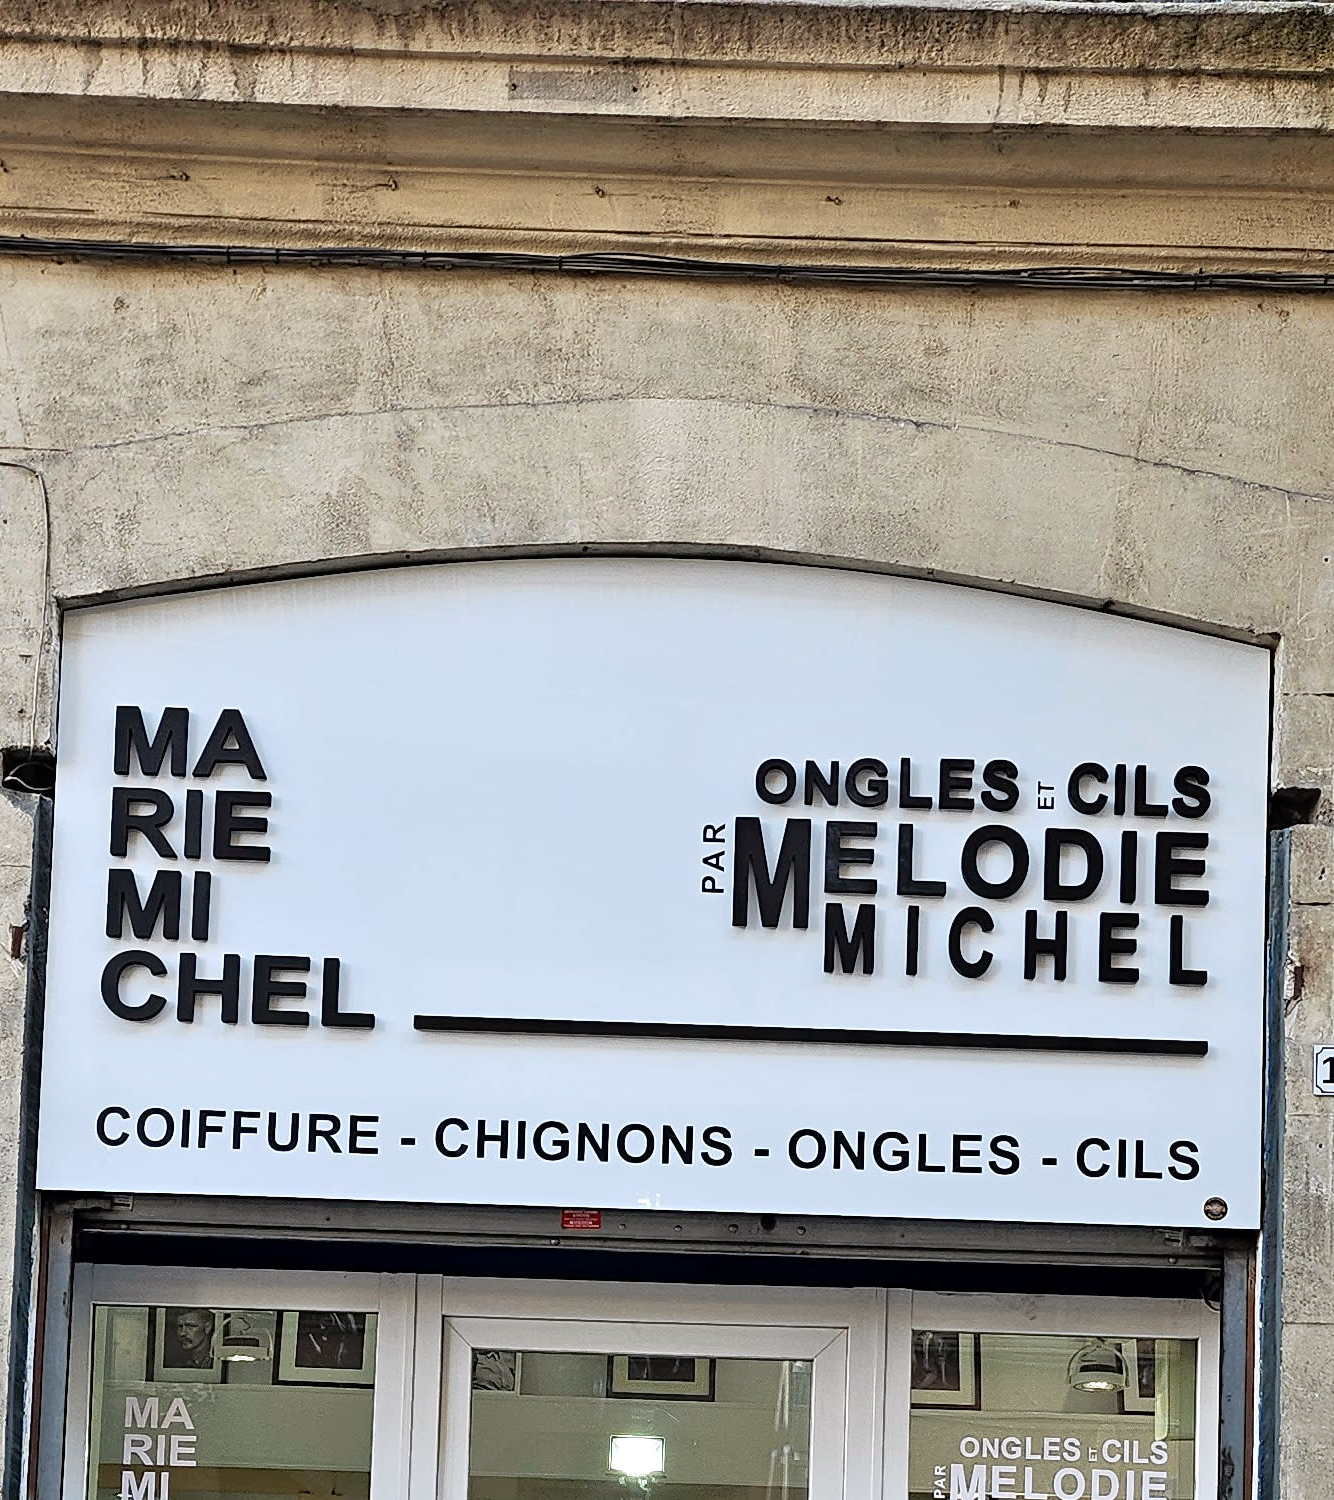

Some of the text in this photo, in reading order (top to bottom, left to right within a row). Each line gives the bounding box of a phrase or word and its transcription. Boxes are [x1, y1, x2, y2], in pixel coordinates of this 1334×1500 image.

[114, 706, 267, 782] MA
[110, 787, 272, 864] RIE
[756, 758, 1211, 820] ONGLES ET CILS
[702, 824, 725, 893] PAR
[732, 816, 1211, 930] MELODIE
[106, 869, 211, 942] MI
[824, 902, 1208, 987] MICHEL
[101, 950, 375, 1030] CHEL
[97, 1107, 379, 1154] COIFFURE
[436, 1118, 732, 1166] CHIGNONS
[789, 1129, 1019, 1175] ONGLES
[1077, 1138, 1199, 1180] CILS
[124, 1396, 196, 1429] MA
[122, 1434, 197, 1467] RIE
[933, 1464, 946, 1499] PAR
[959, 1436, 1081, 1461] ONGLES
[1101, 1439, 1168, 1464] CILS
